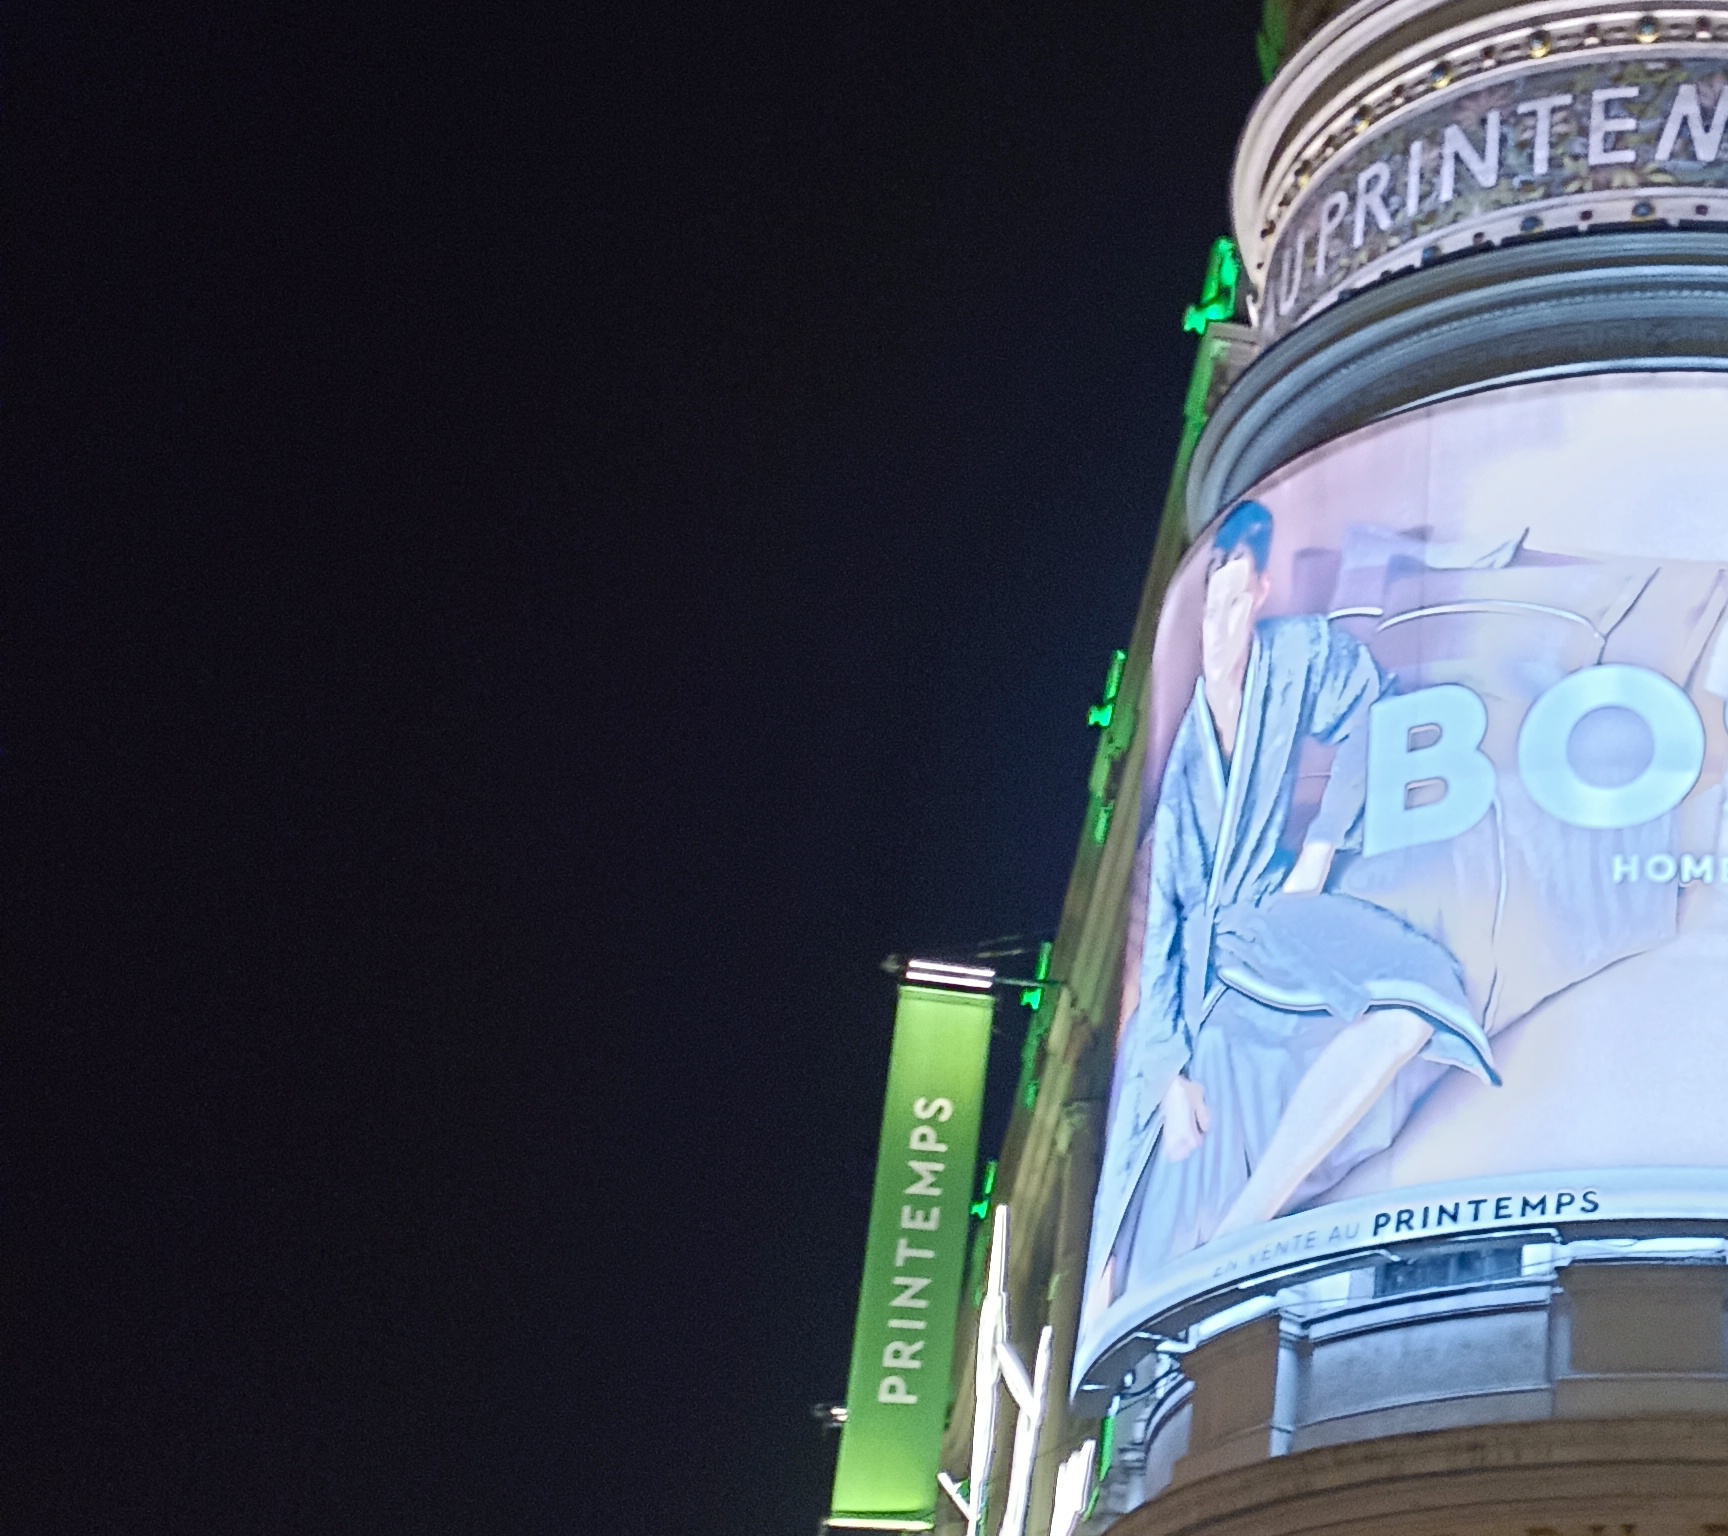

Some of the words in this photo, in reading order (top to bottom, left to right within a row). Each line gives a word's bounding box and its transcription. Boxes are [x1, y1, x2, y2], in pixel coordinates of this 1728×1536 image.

[877, 1095, 954, 1406] PRINTEMPS
[1249, 1229, 1317, 1263] VENTE
[1328, 1221, 1361, 1241] AU
[1372, 1190, 1601, 1238] PRINTEMPS
